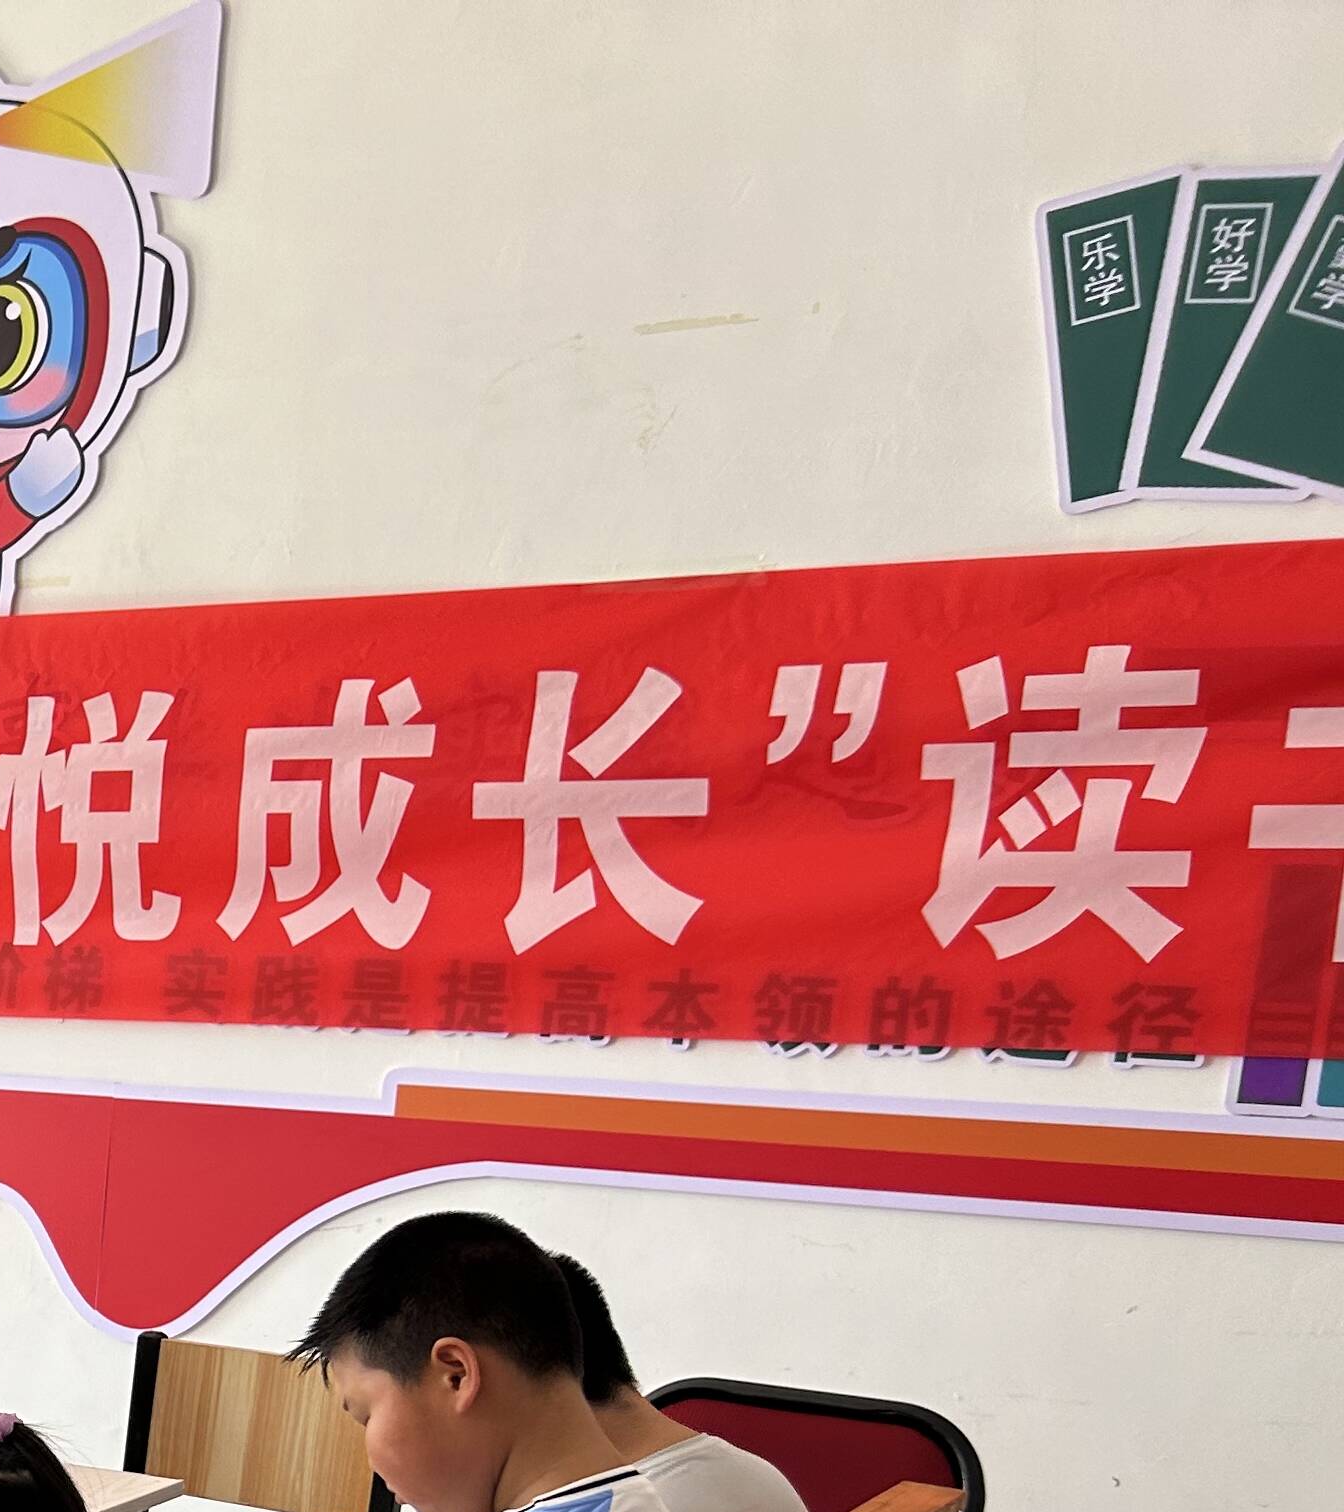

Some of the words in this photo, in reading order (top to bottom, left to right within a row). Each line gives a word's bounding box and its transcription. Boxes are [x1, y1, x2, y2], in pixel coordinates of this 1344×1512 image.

[1080, 232, 1127, 307] 乐学
[1203, 216, 1256, 293] 好学
[1311, 238, 1344, 311] 学
